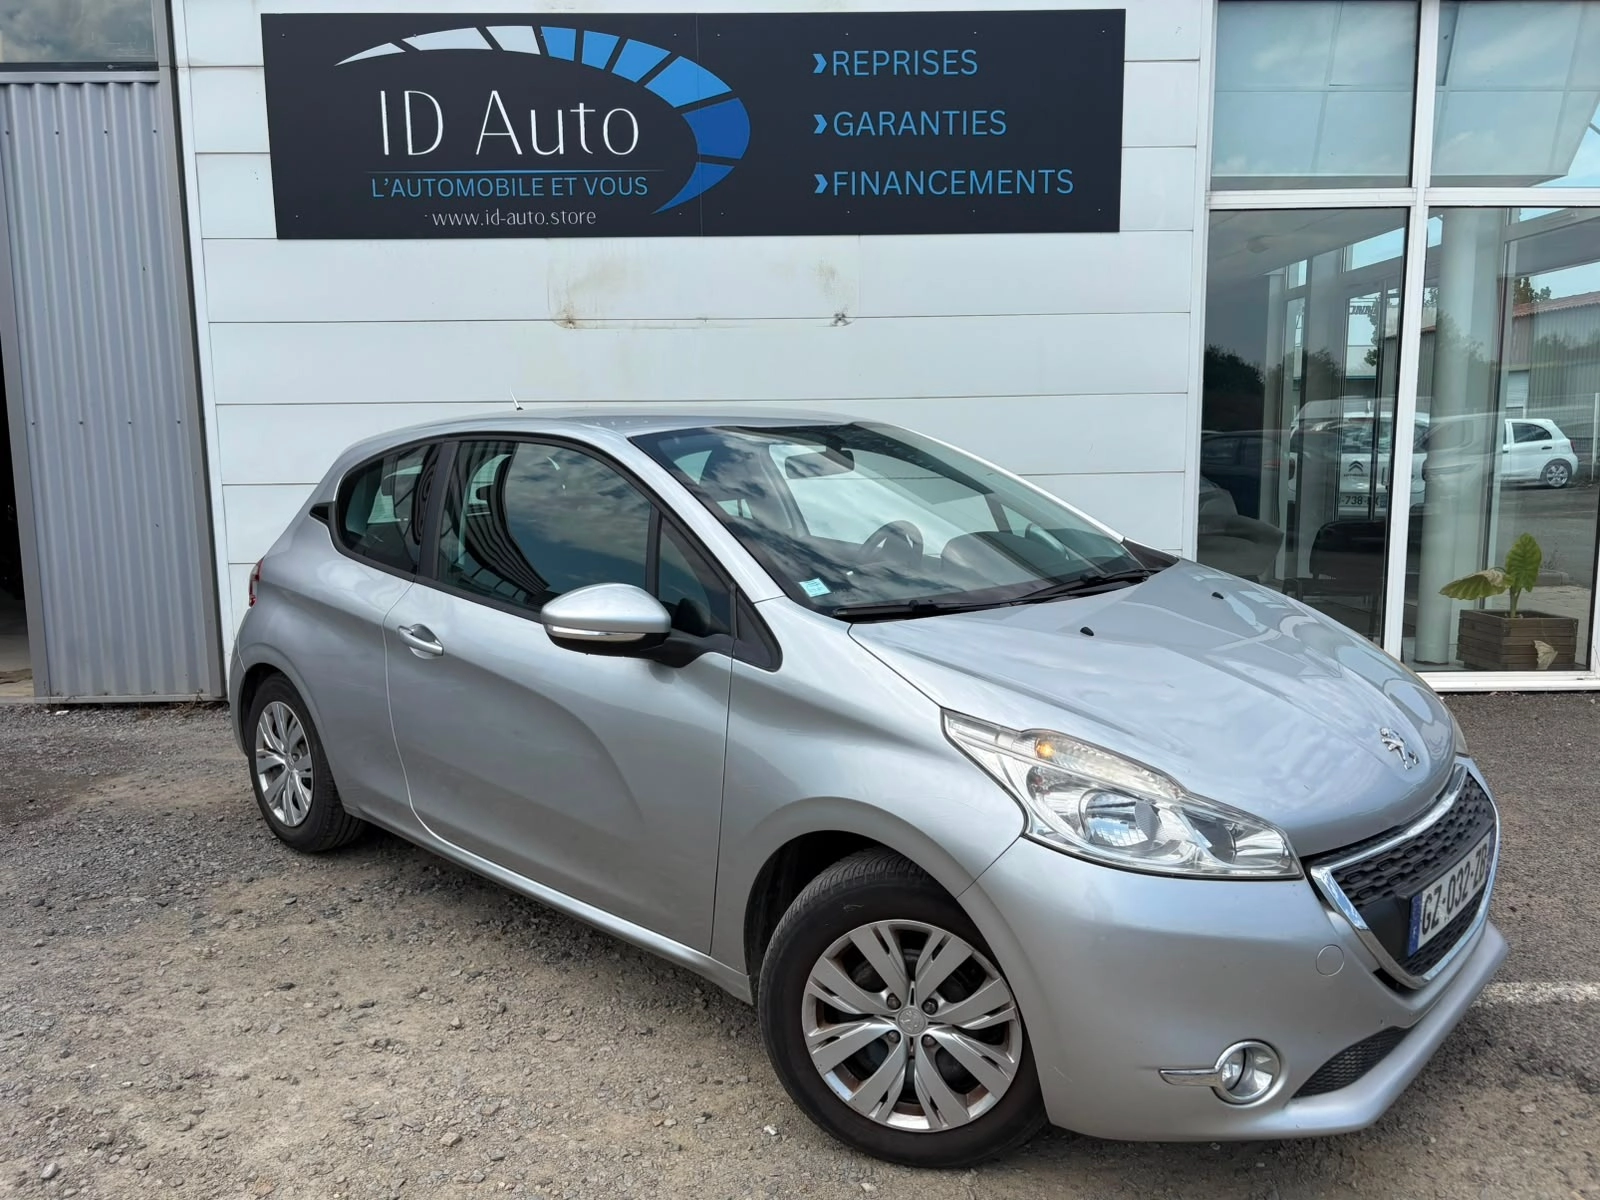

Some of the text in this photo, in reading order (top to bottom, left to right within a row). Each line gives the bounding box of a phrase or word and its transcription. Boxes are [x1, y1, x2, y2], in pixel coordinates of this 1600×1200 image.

[832, 49, 978, 76] REPRISES
[380, 90, 639, 156] ID Auto
[833, 110, 1007, 137] GARANTIES
[371, 176, 648, 198] L’AUTOMOBILE ET VOUS
[833, 169, 1074, 196] FINANCEMENTS
[432, 207, 597, 226] www.id-auto.store
